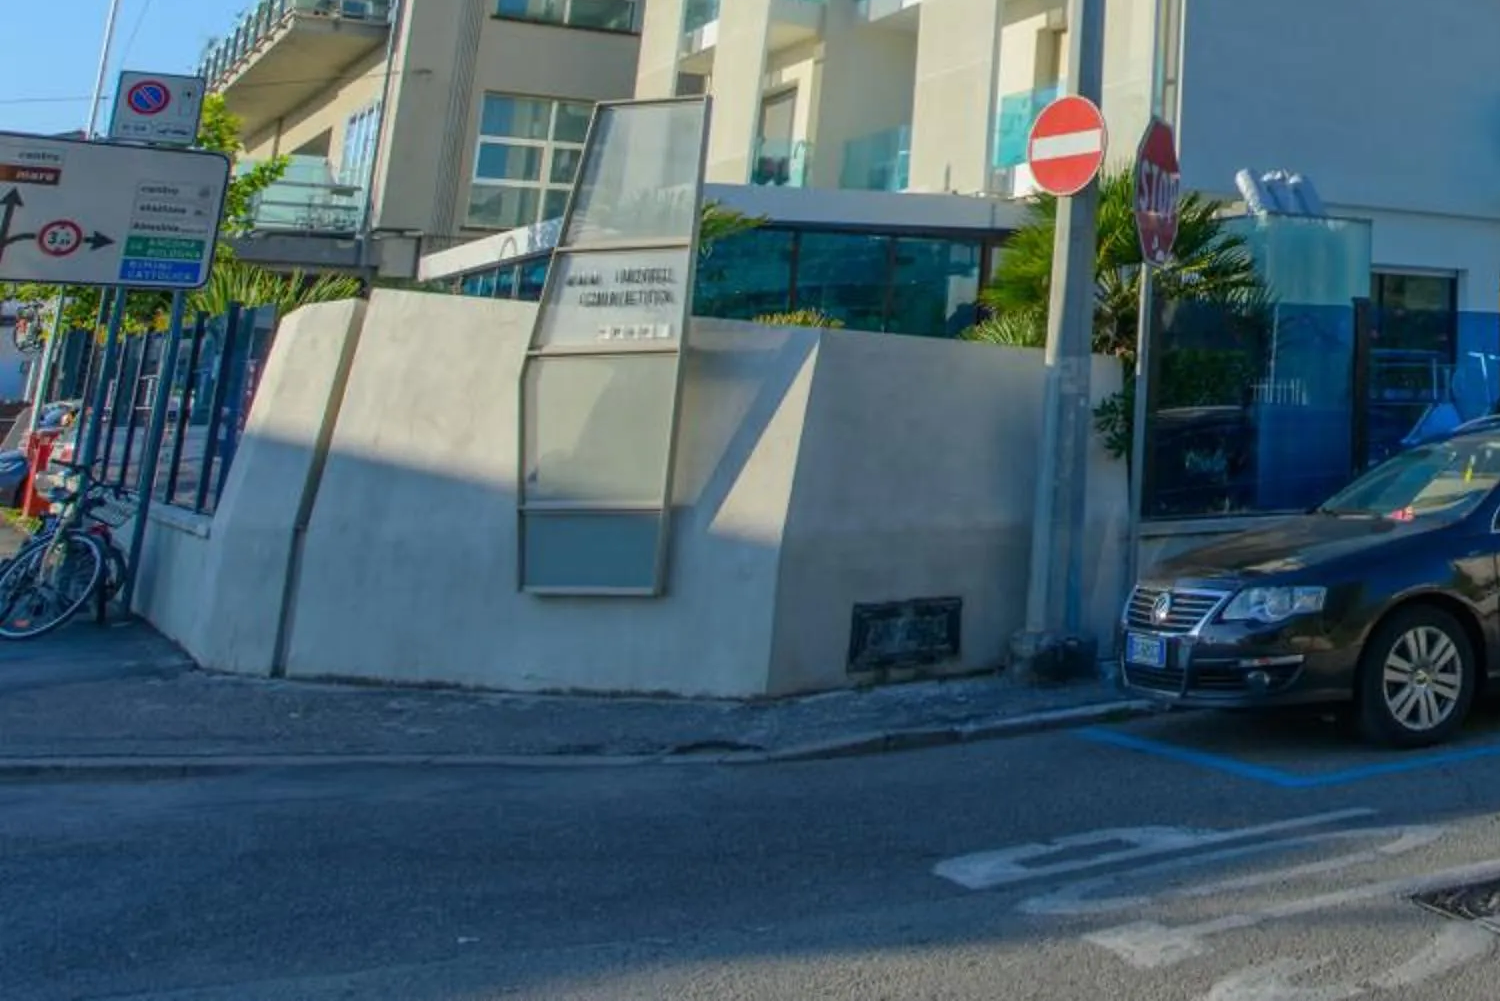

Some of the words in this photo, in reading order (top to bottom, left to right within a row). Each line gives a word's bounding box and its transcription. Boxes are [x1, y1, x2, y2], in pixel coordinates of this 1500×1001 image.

[15, 169, 57, 182] mare
[1139, 160, 1180, 223] STOP
[128, 261, 175, 271] RIMINI
